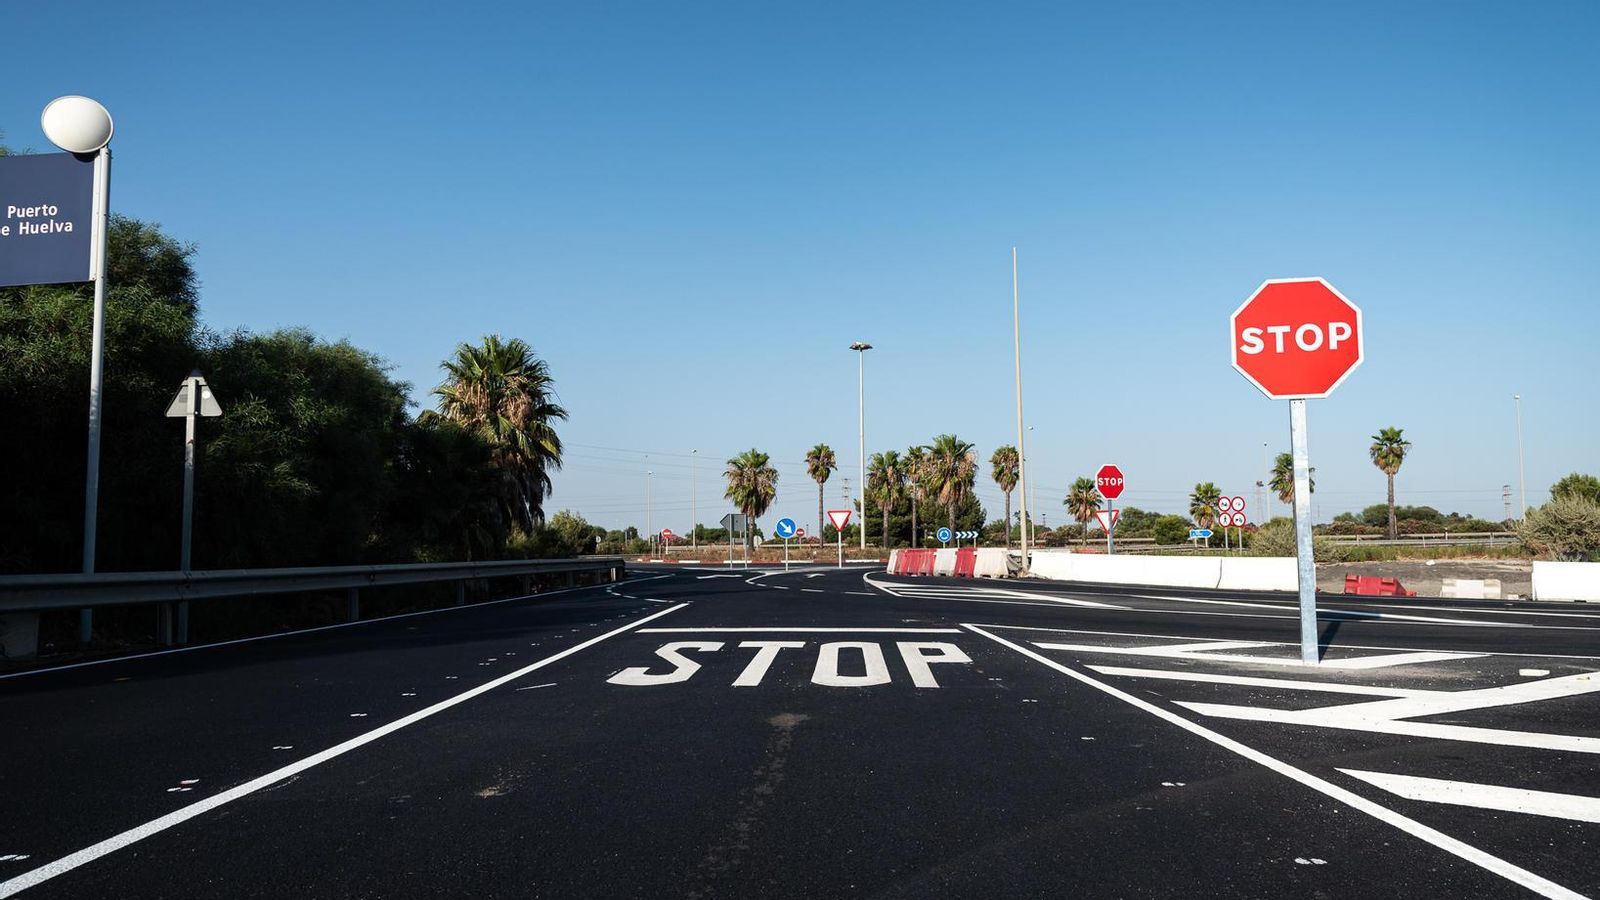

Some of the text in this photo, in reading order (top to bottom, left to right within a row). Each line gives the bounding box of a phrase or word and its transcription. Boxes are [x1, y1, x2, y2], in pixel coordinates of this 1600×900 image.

[7, 204, 58, 218] Puerto
[0, 219, 73, 236] e Huelva
[1240, 321, 1352, 355] STOP
[1098, 477, 1123, 486] STOP
[606, 641, 973, 688] STOP
